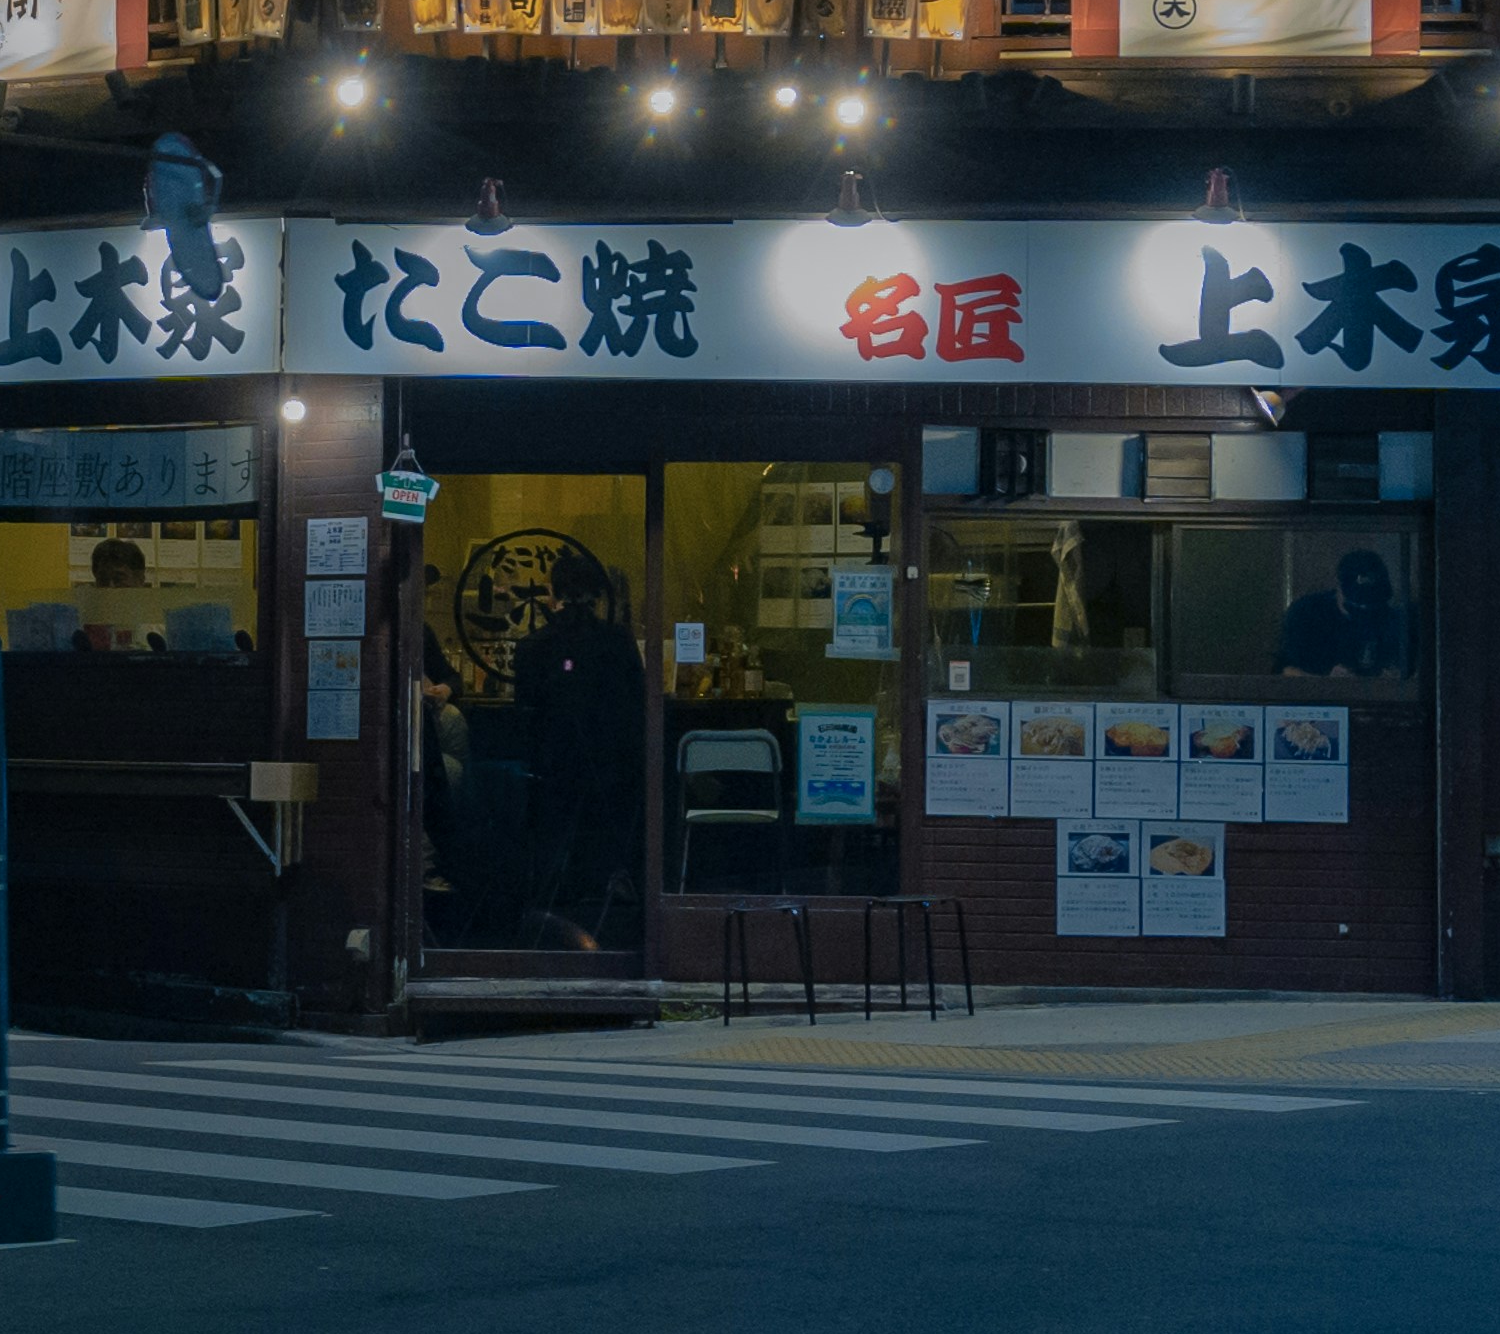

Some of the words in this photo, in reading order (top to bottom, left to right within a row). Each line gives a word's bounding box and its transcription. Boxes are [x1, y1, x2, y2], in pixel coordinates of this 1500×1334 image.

[334, 238, 700, 359] たこ焼
[839, 271, 1025, 363] 名匠
[391, 489, 420, 503] OPEN
